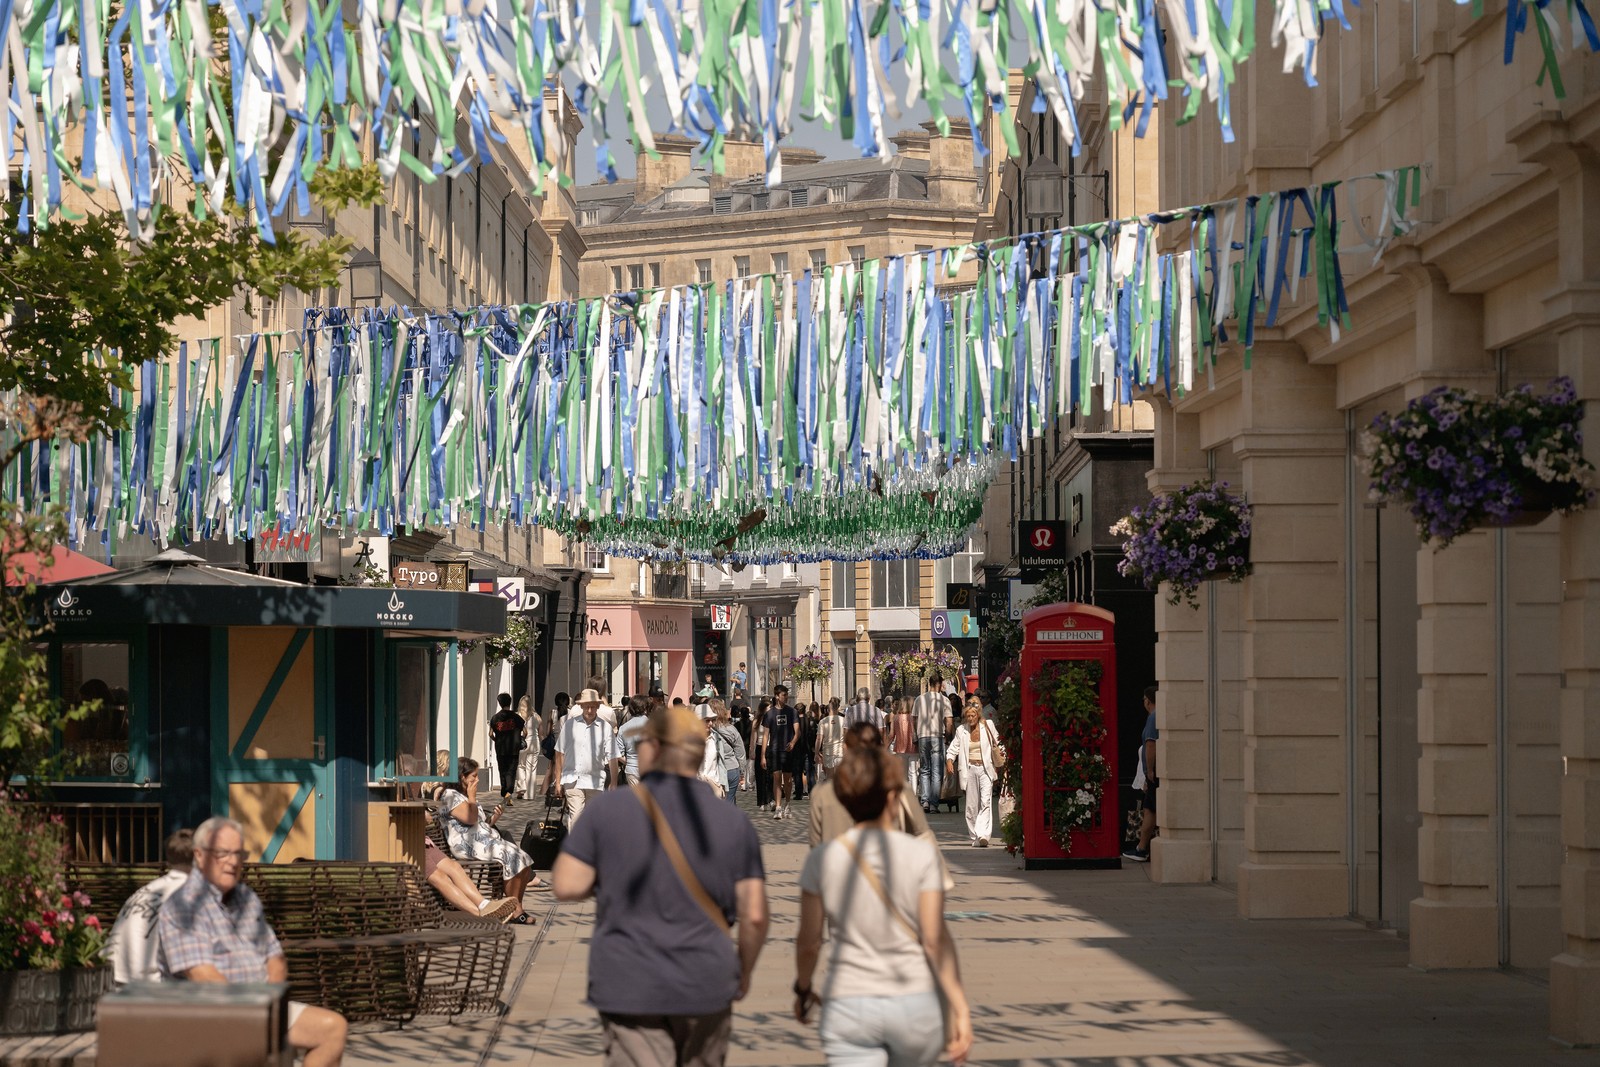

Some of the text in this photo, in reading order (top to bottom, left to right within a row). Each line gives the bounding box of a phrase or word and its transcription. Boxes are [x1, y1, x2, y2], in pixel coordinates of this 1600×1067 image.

[1022, 557, 1064, 565] lululemon
[398, 567, 438, 584] Typo
[766, 606, 777, 615] KFC
[376, 612, 414, 621] MOKOKO
[587, 618, 612, 636] RA
[936, 621, 944, 629] BT
[1040, 631, 1100, 640] TELEPHONE
